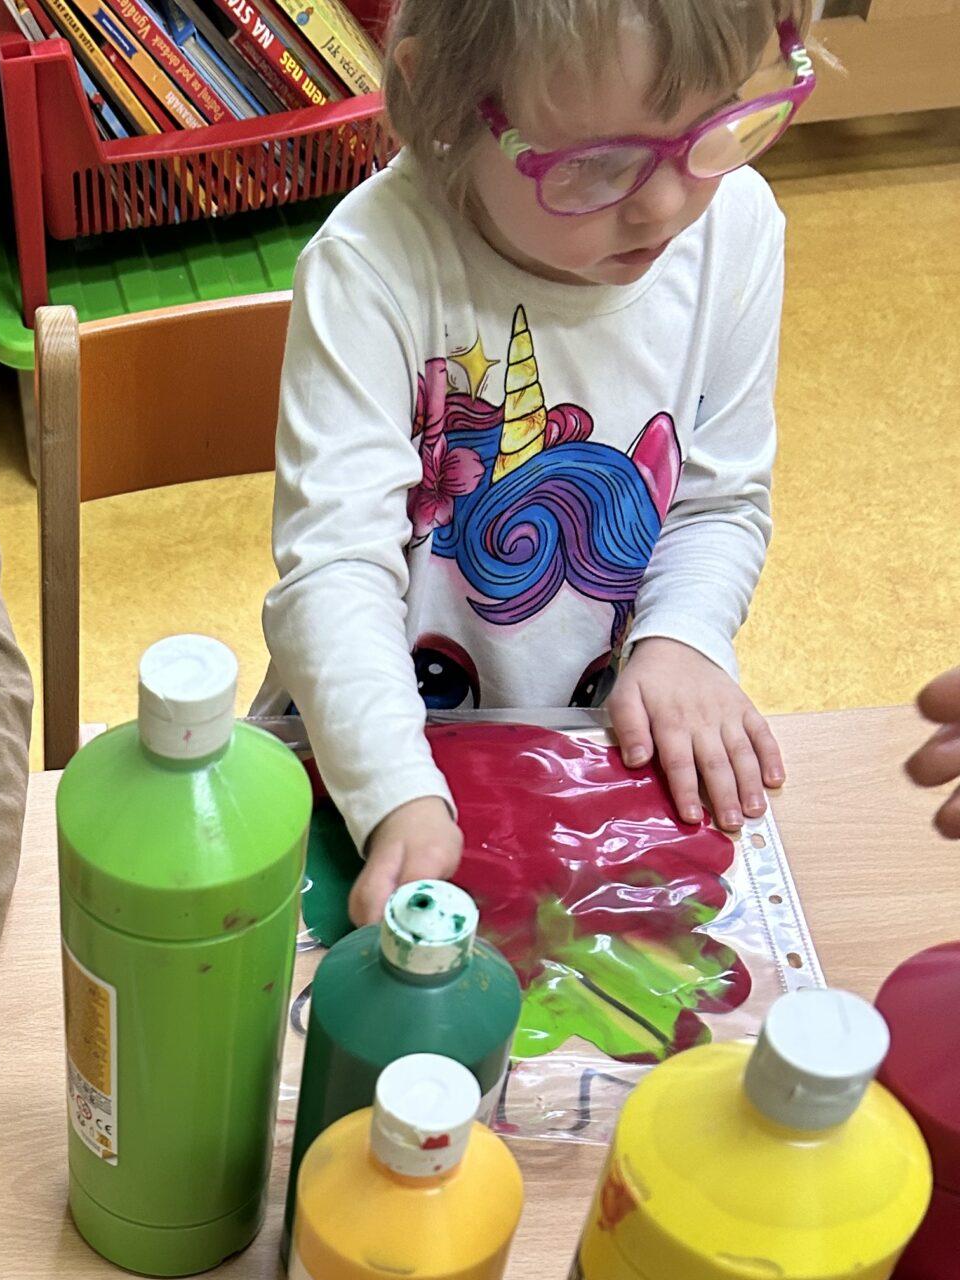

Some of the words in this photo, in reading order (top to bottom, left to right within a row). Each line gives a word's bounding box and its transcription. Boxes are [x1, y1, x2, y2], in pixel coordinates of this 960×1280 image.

[62, 12, 81, 35] ATLAS
[117, 0, 151, 40] Vynále
[251, 17, 275, 49] NA
[151, 34, 181, 67] obrázek
[279, 50, 304, 82] nás
[320, 35, 341, 58] Jak
[354, 74, 374, 95] fun
[175, 63, 196, 83] pod
[191, 81, 202, 92] se
